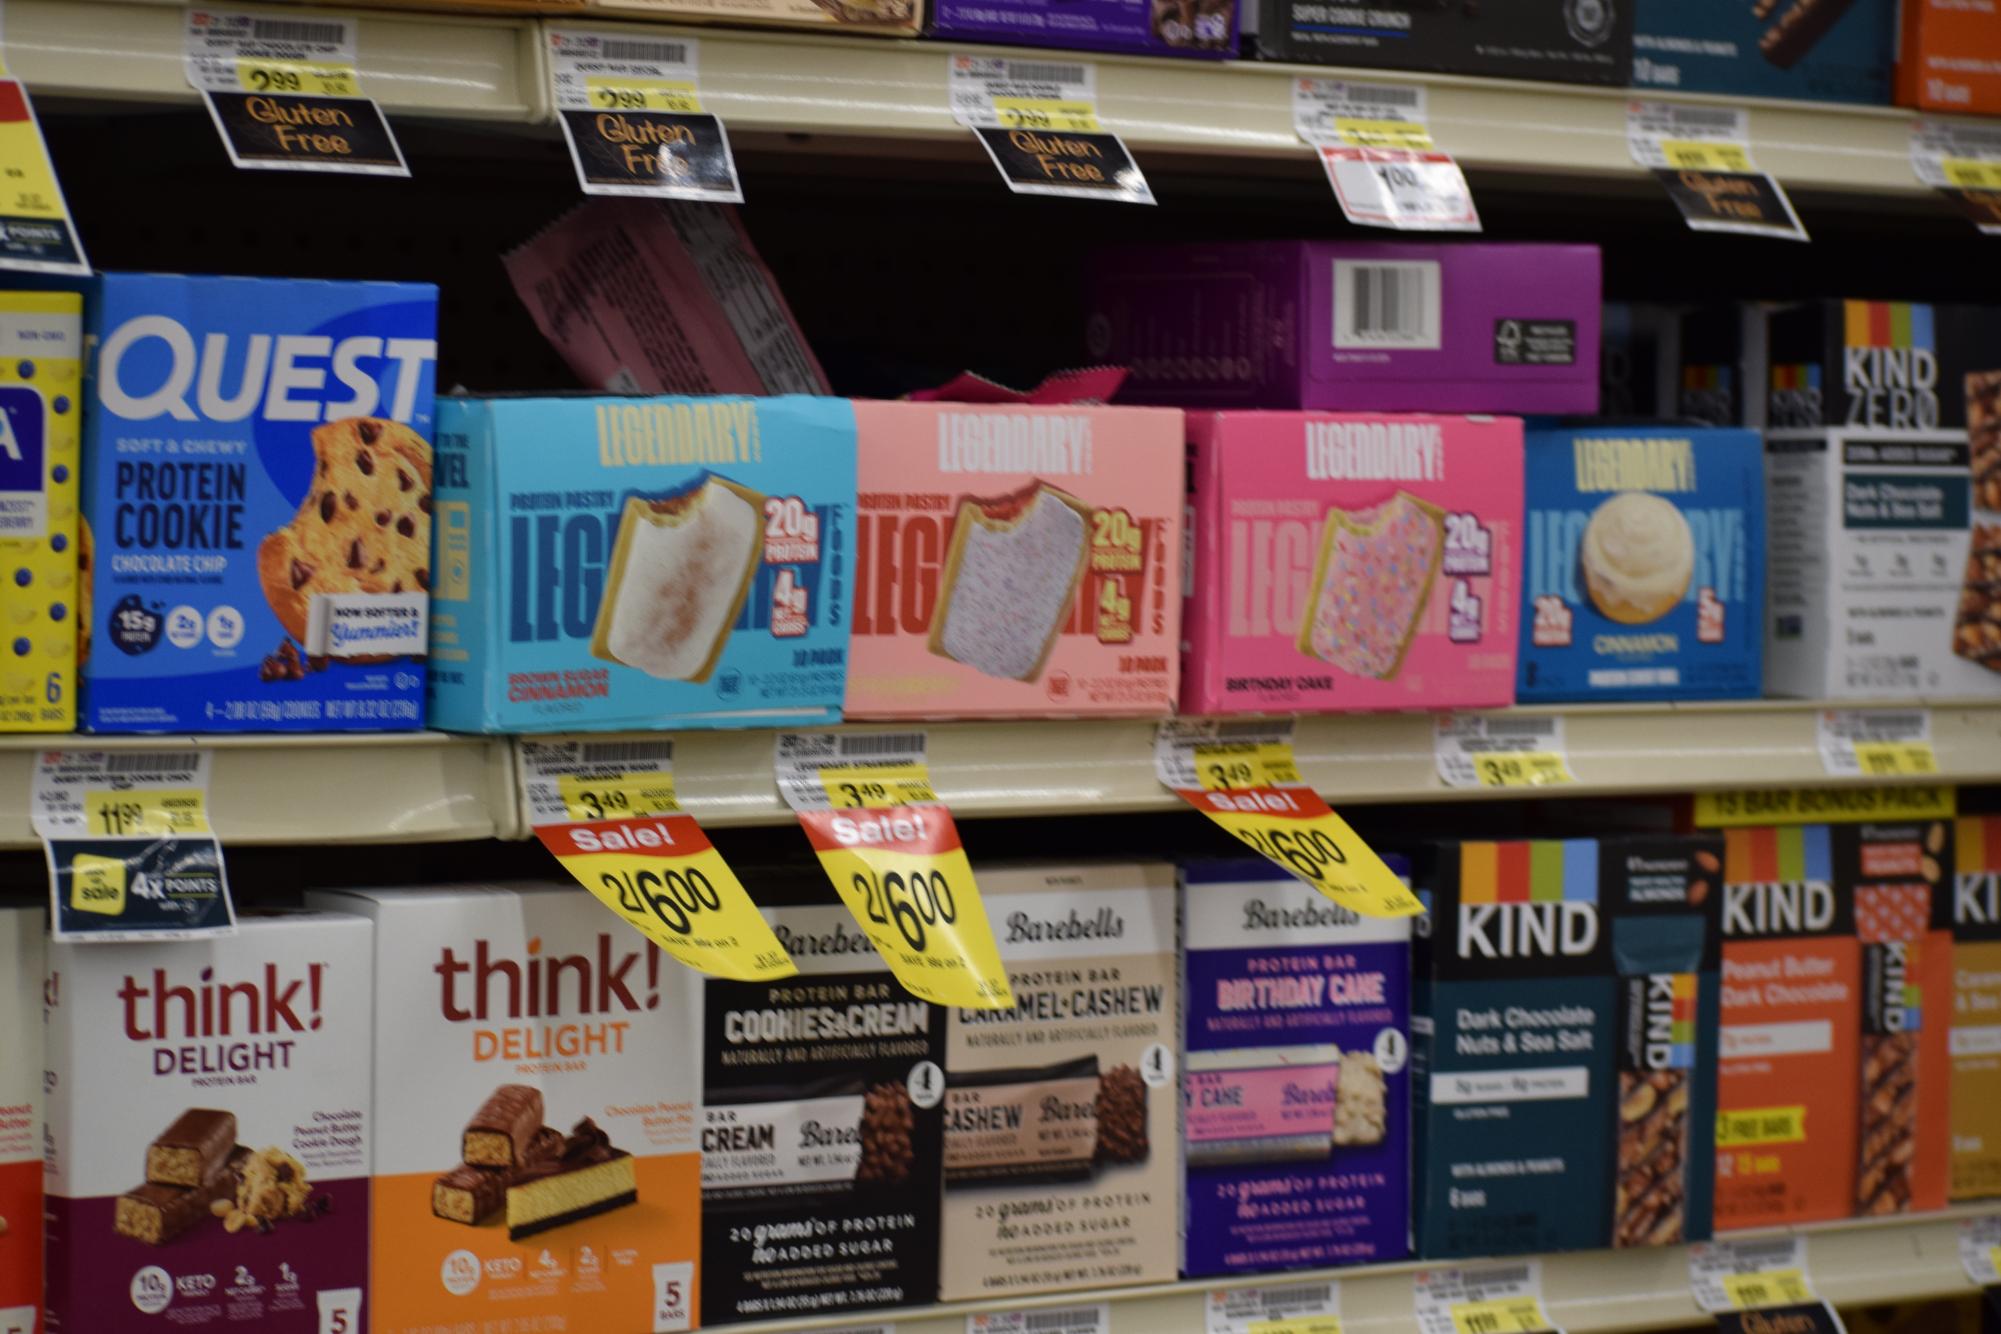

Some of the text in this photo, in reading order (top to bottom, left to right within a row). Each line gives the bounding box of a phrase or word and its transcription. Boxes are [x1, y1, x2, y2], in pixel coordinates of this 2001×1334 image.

[246, 96, 353, 127] Gluten
[273, 124, 351, 154] Free
[595, 113, 697, 145] Gluten
[1009, 129, 1103, 159] Gluten
[1037, 154, 1105, 182] Free
[99, 315, 438, 422] QUEST
[1844, 346, 1939, 392] KIND
[116, 438, 247, 456] SOFT & CHEWY
[597, 401, 752, 468] LEGENDARY
[938, 413, 1085, 474] LEGENDARY
[1305, 421, 1437, 481] LEGENDARY
[115, 461, 246, 502] PROTEIN
[115, 503, 244, 550] COOKIE
[765, 497, 818, 542] 20g
[118, 610, 156, 632] 15g
[47, 671, 62, 704] 6
[1205, 790, 1300, 811] Sale!
[569, 822, 676, 851] Sale!
[831, 813, 927, 845] Sale!
[166, 877, 218, 893] POINTS
[1722, 880, 1836, 934] KIND
[1005, 905, 1124, 944] Barebells
[1457, 902, 1600, 958] KIND
[433, 932, 661, 1023] think!
[1010, 967, 1121, 987] PROTEIN BAR
[1247, 955, 1357, 973] PROTEIN BAR
[1723, 957, 1781, 980] Peanut
[117, 962, 324, 1042] think!
[768, 983, 891, 1004] PROTEIN BAR
[1216, 972, 1386, 1010] BIRTHDAY CAKE
[1456, 1004, 1596, 1030] Dark Chocolate
[1647, 973, 1674, 1070] KIND
[473, 1021, 630, 1062] DELIGHT
[1455, 1029, 1594, 1055] Nuts & Sea Salt
[152, 1041, 296, 1077] DELIGHT
[702, 1124, 775, 1152] CREAM
[1318, 1172, 1386, 1191] PROTEIN
[1081, 1191, 1151, 1211] PROTEIN
[729, 1226, 752, 1243] 20
[842, 1213, 916, 1233] PROTEIN
[1079, 1215, 1131, 1232] SUGAR
[777, 1238, 894, 1261] ADDED SUGAR
[175, 1273, 217, 1290] KETO
[665, 1280, 682, 1307] 5
[331, 1308, 346, 1334] 5
